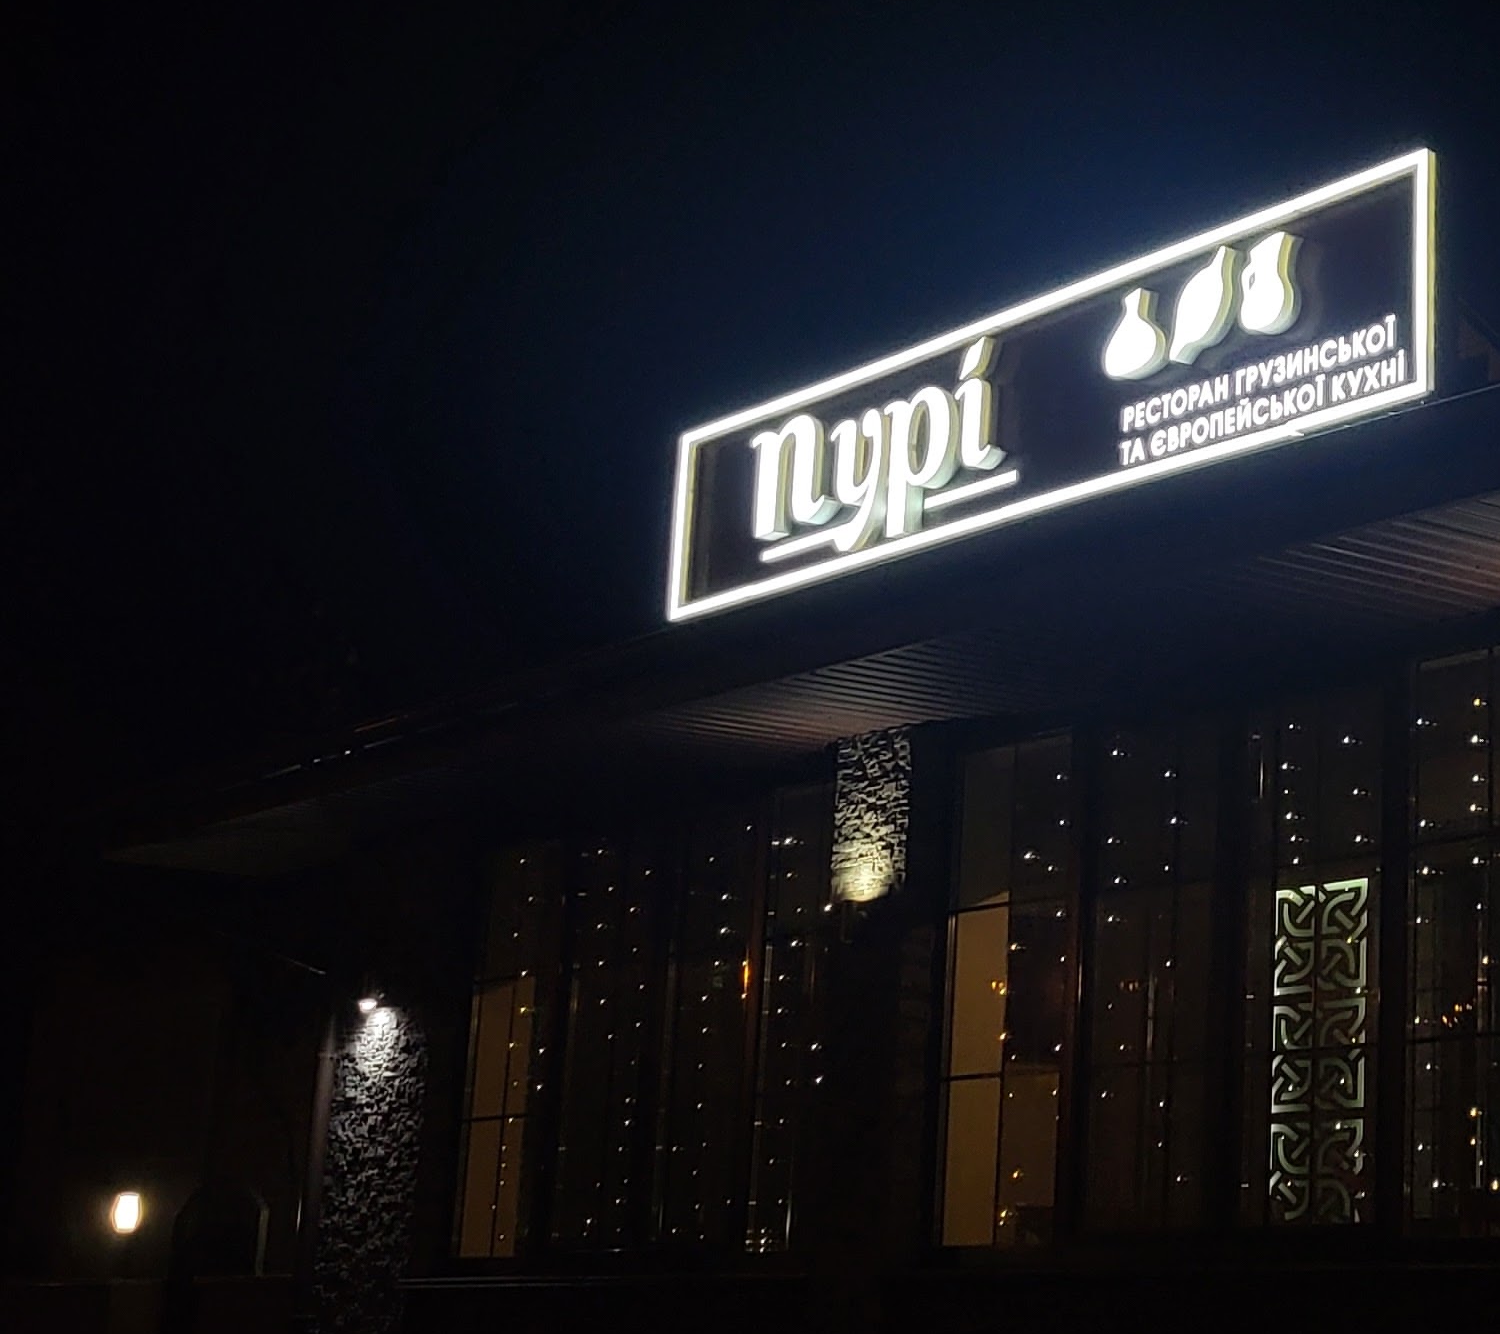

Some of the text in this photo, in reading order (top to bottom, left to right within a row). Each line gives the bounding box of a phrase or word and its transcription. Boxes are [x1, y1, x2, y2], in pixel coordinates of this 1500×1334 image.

[1119, 348, 1407, 466] ТА ЄВРОПЕЙСЬКОЇ КУХНІ
[1121, 313, 1396, 433] РЕСТОРАН ГРУЗИНСЬКОЇ
